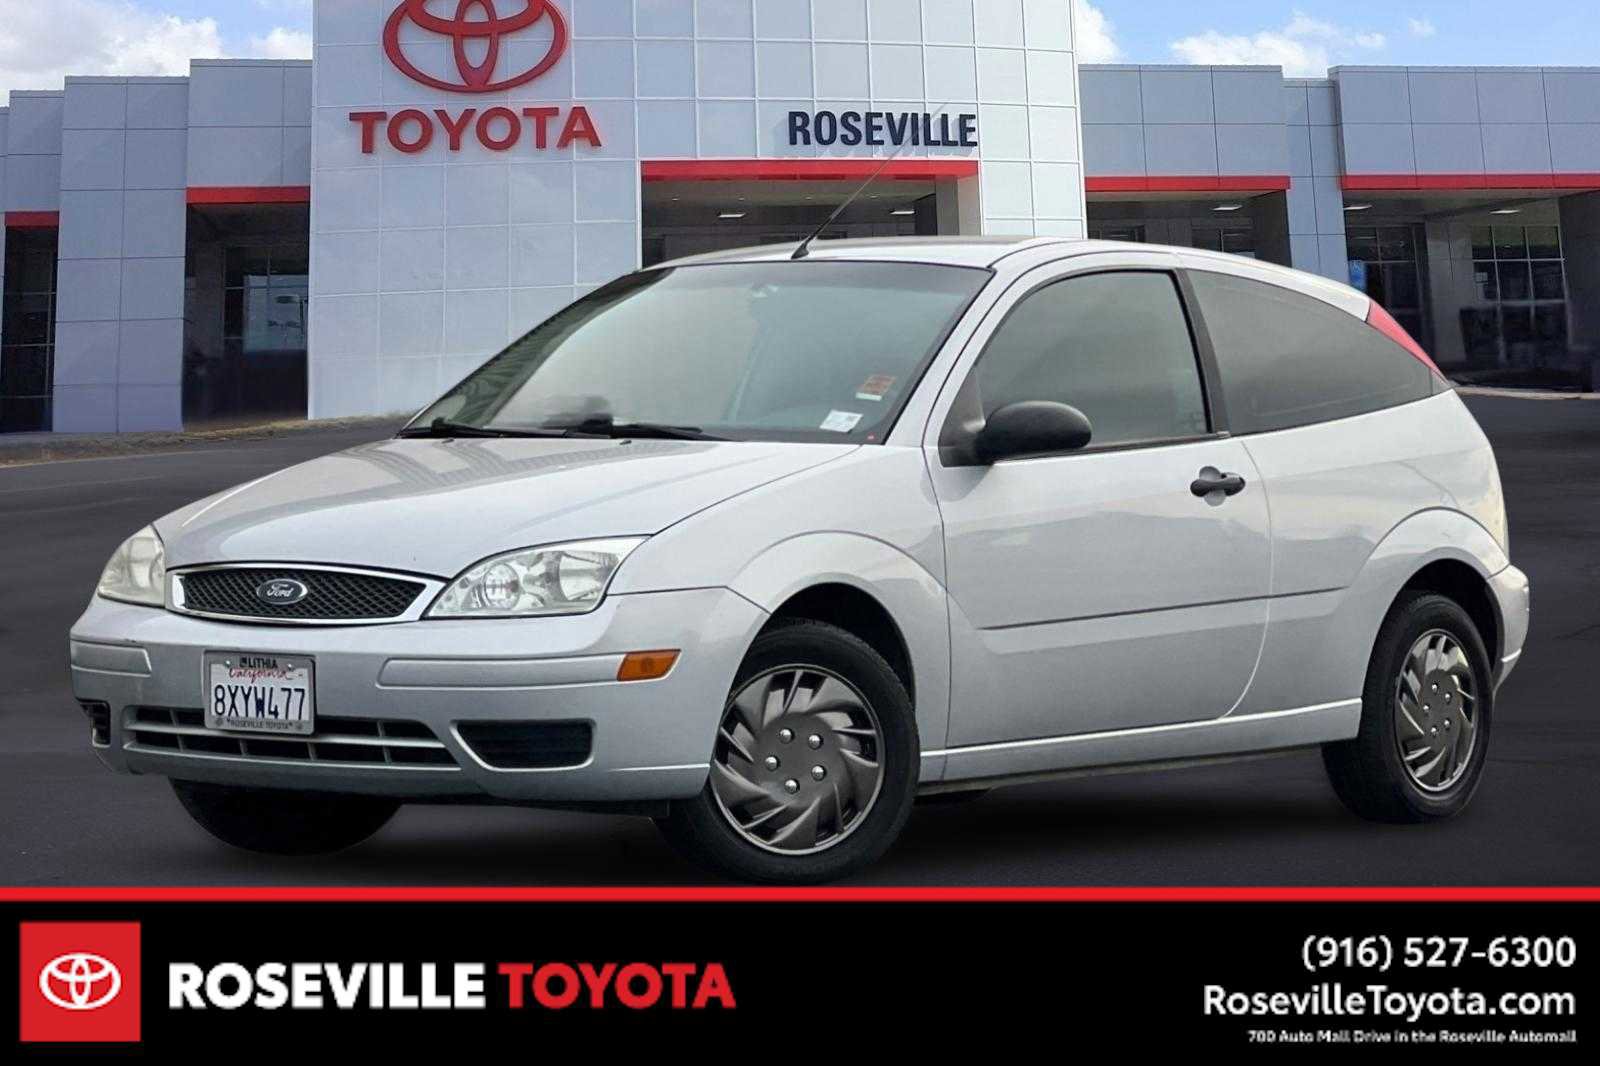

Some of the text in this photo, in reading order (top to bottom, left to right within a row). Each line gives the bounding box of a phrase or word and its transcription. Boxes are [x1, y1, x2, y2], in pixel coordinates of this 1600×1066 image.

[349, 105, 602, 153] TOYOTA
[788, 111, 978, 147] ROSEVILLE
[267, 583, 294, 597] Ford
[229, 666, 289, 684] California
[248, 657, 278, 668] LITHIA
[214, 684, 305, 720] 8XYW477
